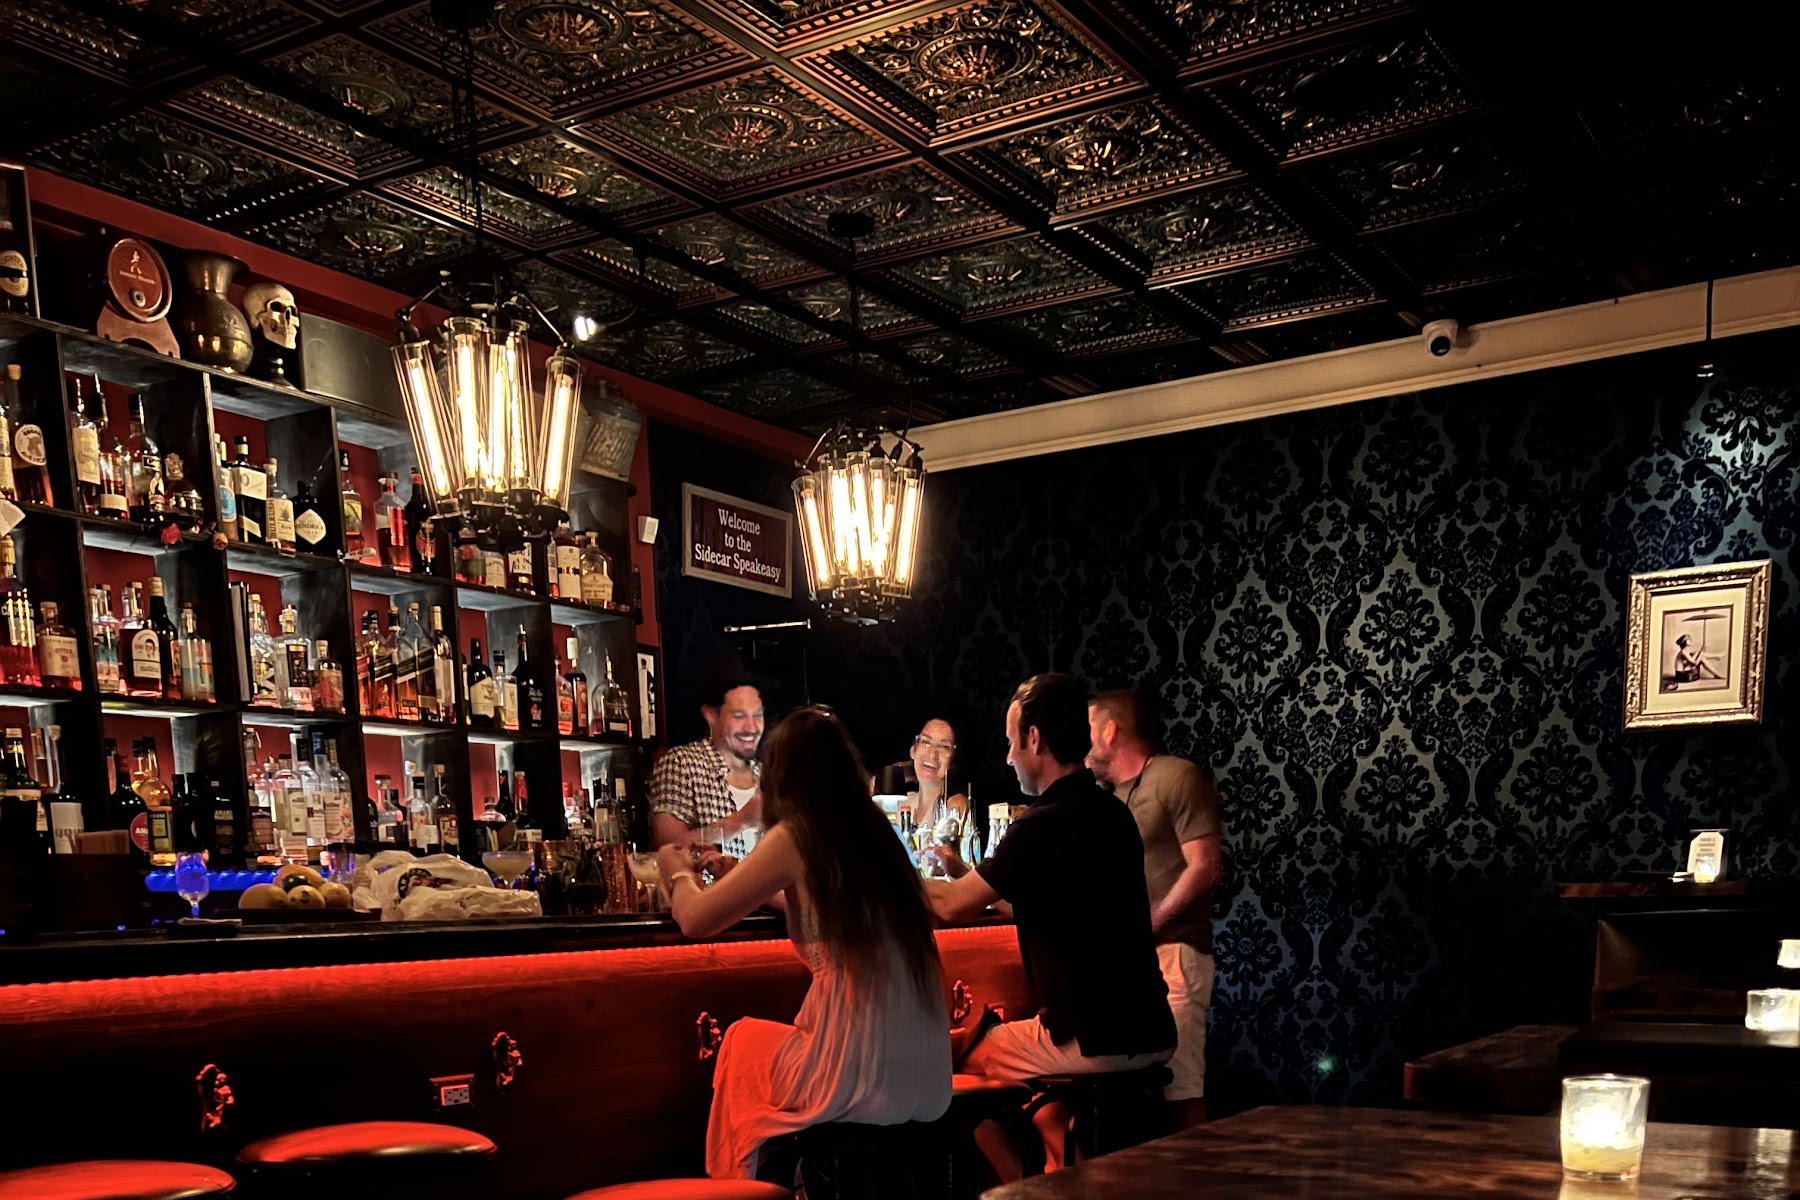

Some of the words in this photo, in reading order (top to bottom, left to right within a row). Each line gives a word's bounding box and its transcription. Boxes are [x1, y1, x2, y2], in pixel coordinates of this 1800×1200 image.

[718, 508, 760, 535] Welcome
[724, 532, 734, 547] to
[736, 534, 752, 552] the
[695, 543, 731, 567] Sidecar
[733, 553, 781, 582] Speakeasy
